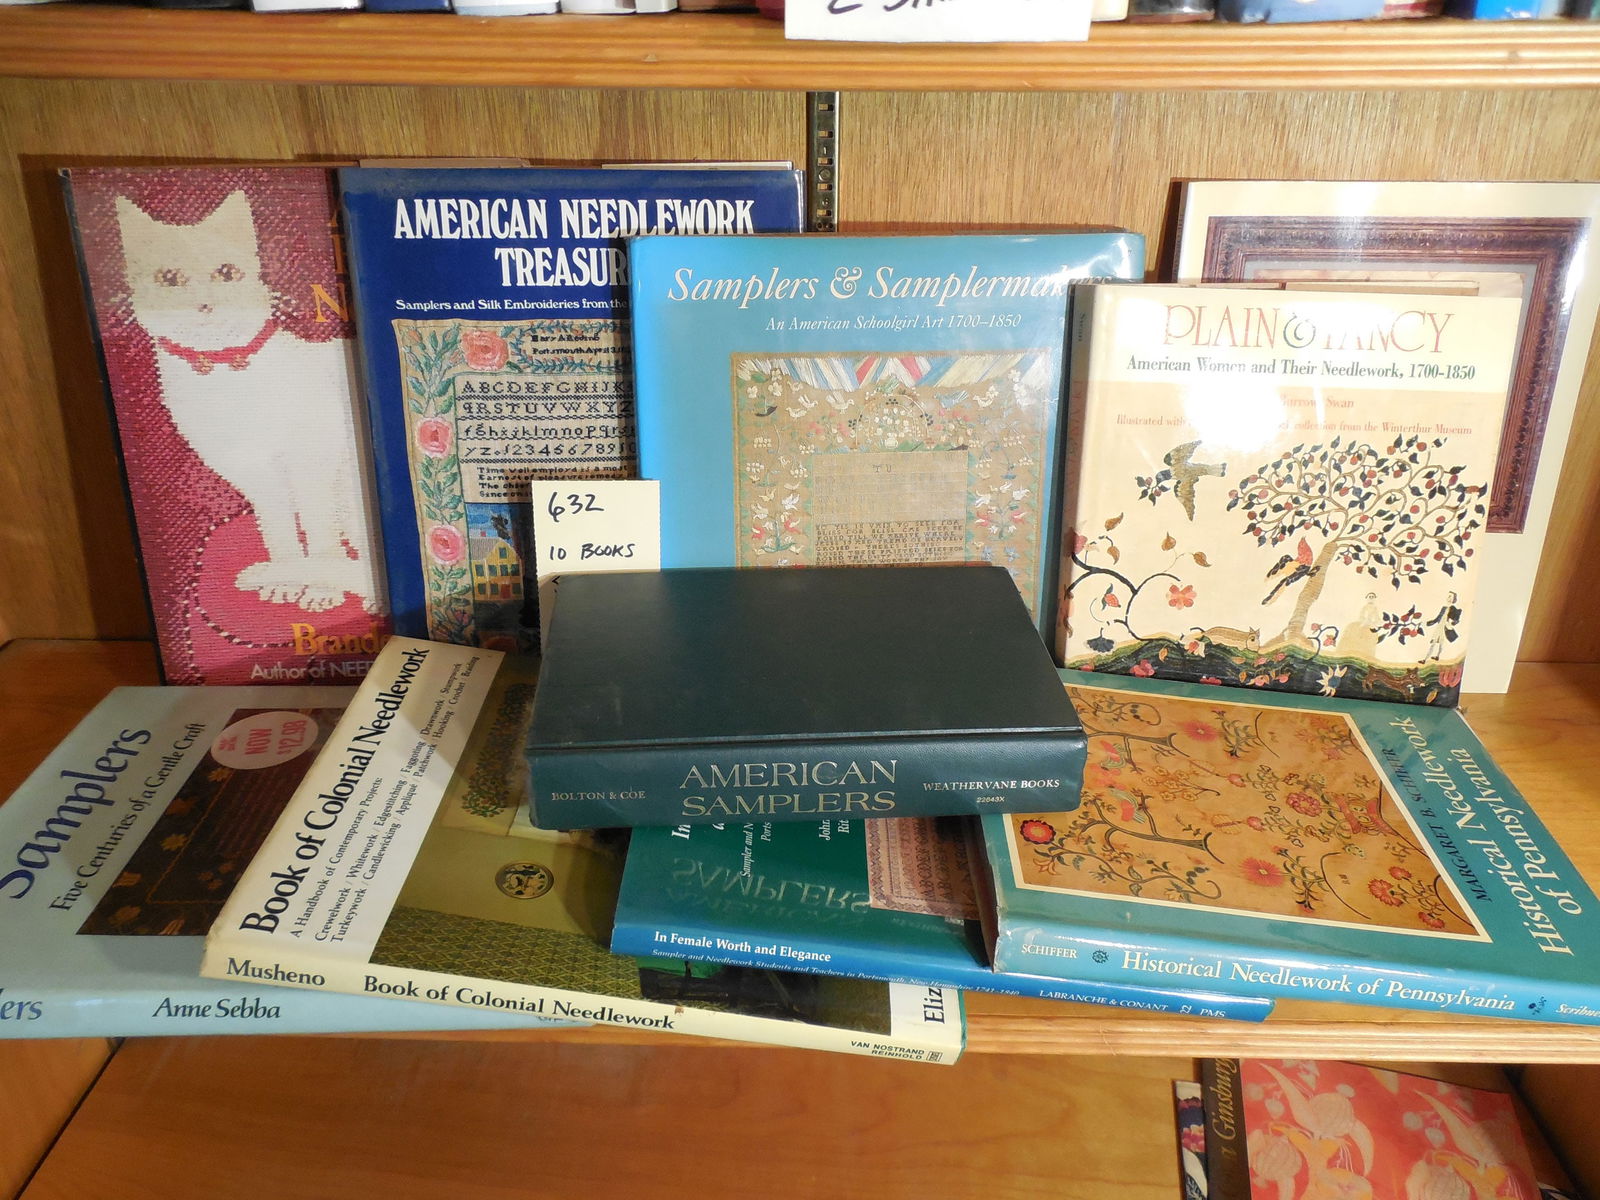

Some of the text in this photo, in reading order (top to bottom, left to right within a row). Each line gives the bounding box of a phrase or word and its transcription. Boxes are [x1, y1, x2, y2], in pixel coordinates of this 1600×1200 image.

[394, 197, 755, 239] AMERICAN NEEDLEWORK
[667, 266, 819, 309] Samplers
[829, 266, 863, 299] &
[395, 298, 628, 311] Samplers and Silk Embroideries from the
[765, 316, 785, 331] An
[788, 315, 851, 331] American
[854, 313, 920, 333] Schoolgirl
[921, 314, 944, 329] Art
[1163, 304, 1280, 349] PLAIN
[1126, 354, 1476, 381] American Women and Their Needlework, 1700-1850
[1326, 398, 1355, 410] Swan
[1338, 422, 1362, 433] from
[1363, 423, 1379, 433] the
[1381, 422, 1433, 435] Winterthur
[1435, 424, 1473, 436] Museum
[547, 491, 605, 523] 632
[549, 542, 636, 561] 10 BOOKS
[250, 661, 307, 680] Author
[308, 659, 325, 678] of
[239, 647, 430, 934] Book of Colonial Needlework
[679, 759, 898, 790] AMERICAN
[922, 779, 1060, 791] WEATHERVANE BOOKS
[551, 790, 646, 801] BOLTON & COE
[681, 791, 897, 817] SAMPLERS
[0, 728, 152, 900] Samplers
[48, 722, 207, 912] Five Centuries of a Gentle Craft
[330, 887, 367, 943] Turkeywork
[363, 822, 402, 880] Candlewicking
[413, 743, 438, 778] Patchwork
[432, 710, 455, 739] Hooking
[671, 823, 691, 840] In
[742, 830, 754, 846] and
[1389, 716, 1576, 957] Historical Needlework
[1446, 747, 1583, 916] of Pennsylvania
[290, 777, 383, 938] A Handbook of Contemporary Projects:
[314, 887, 352, 942] Crewelwork
[345, 834, 378, 879] Whitework
[373, 779, 407, 827] Edgestitching
[740, 846, 755, 878] Sampler
[1427, 821, 1493, 903] MARGARET
[654, 930, 832, 962] In Female Worth and Elegance
[651, 948, 687, 960] Sampler
[687, 953, 704, 962] and
[705, 956, 753, 967] Needlework
[755, 960, 792, 971] Students
[792, 965, 810, 973] and
[810, 966, 845, 977] Teachers
[1021, 943, 1078, 959] SCHIFFER
[1121, 949, 1222, 979] Historical
[1231, 962, 1353, 993] Needlework
[1357, 978, 1384, 996] of
[1385, 980, 1516, 1012] Pennsylvania
[0, 988, 281, 1021] ers Anne Sebba
[226, 957, 676, 1030] Musheno Book of Colonial Needlework
[922, 986, 946, 1025] Eliz
[1039, 989, 1226, 1018] LABRANCHE & CONANT PMS
[850, 1040, 925, 1056] VAN NOSTRAND
[871, 1049, 923, 1061] REINHOLD
